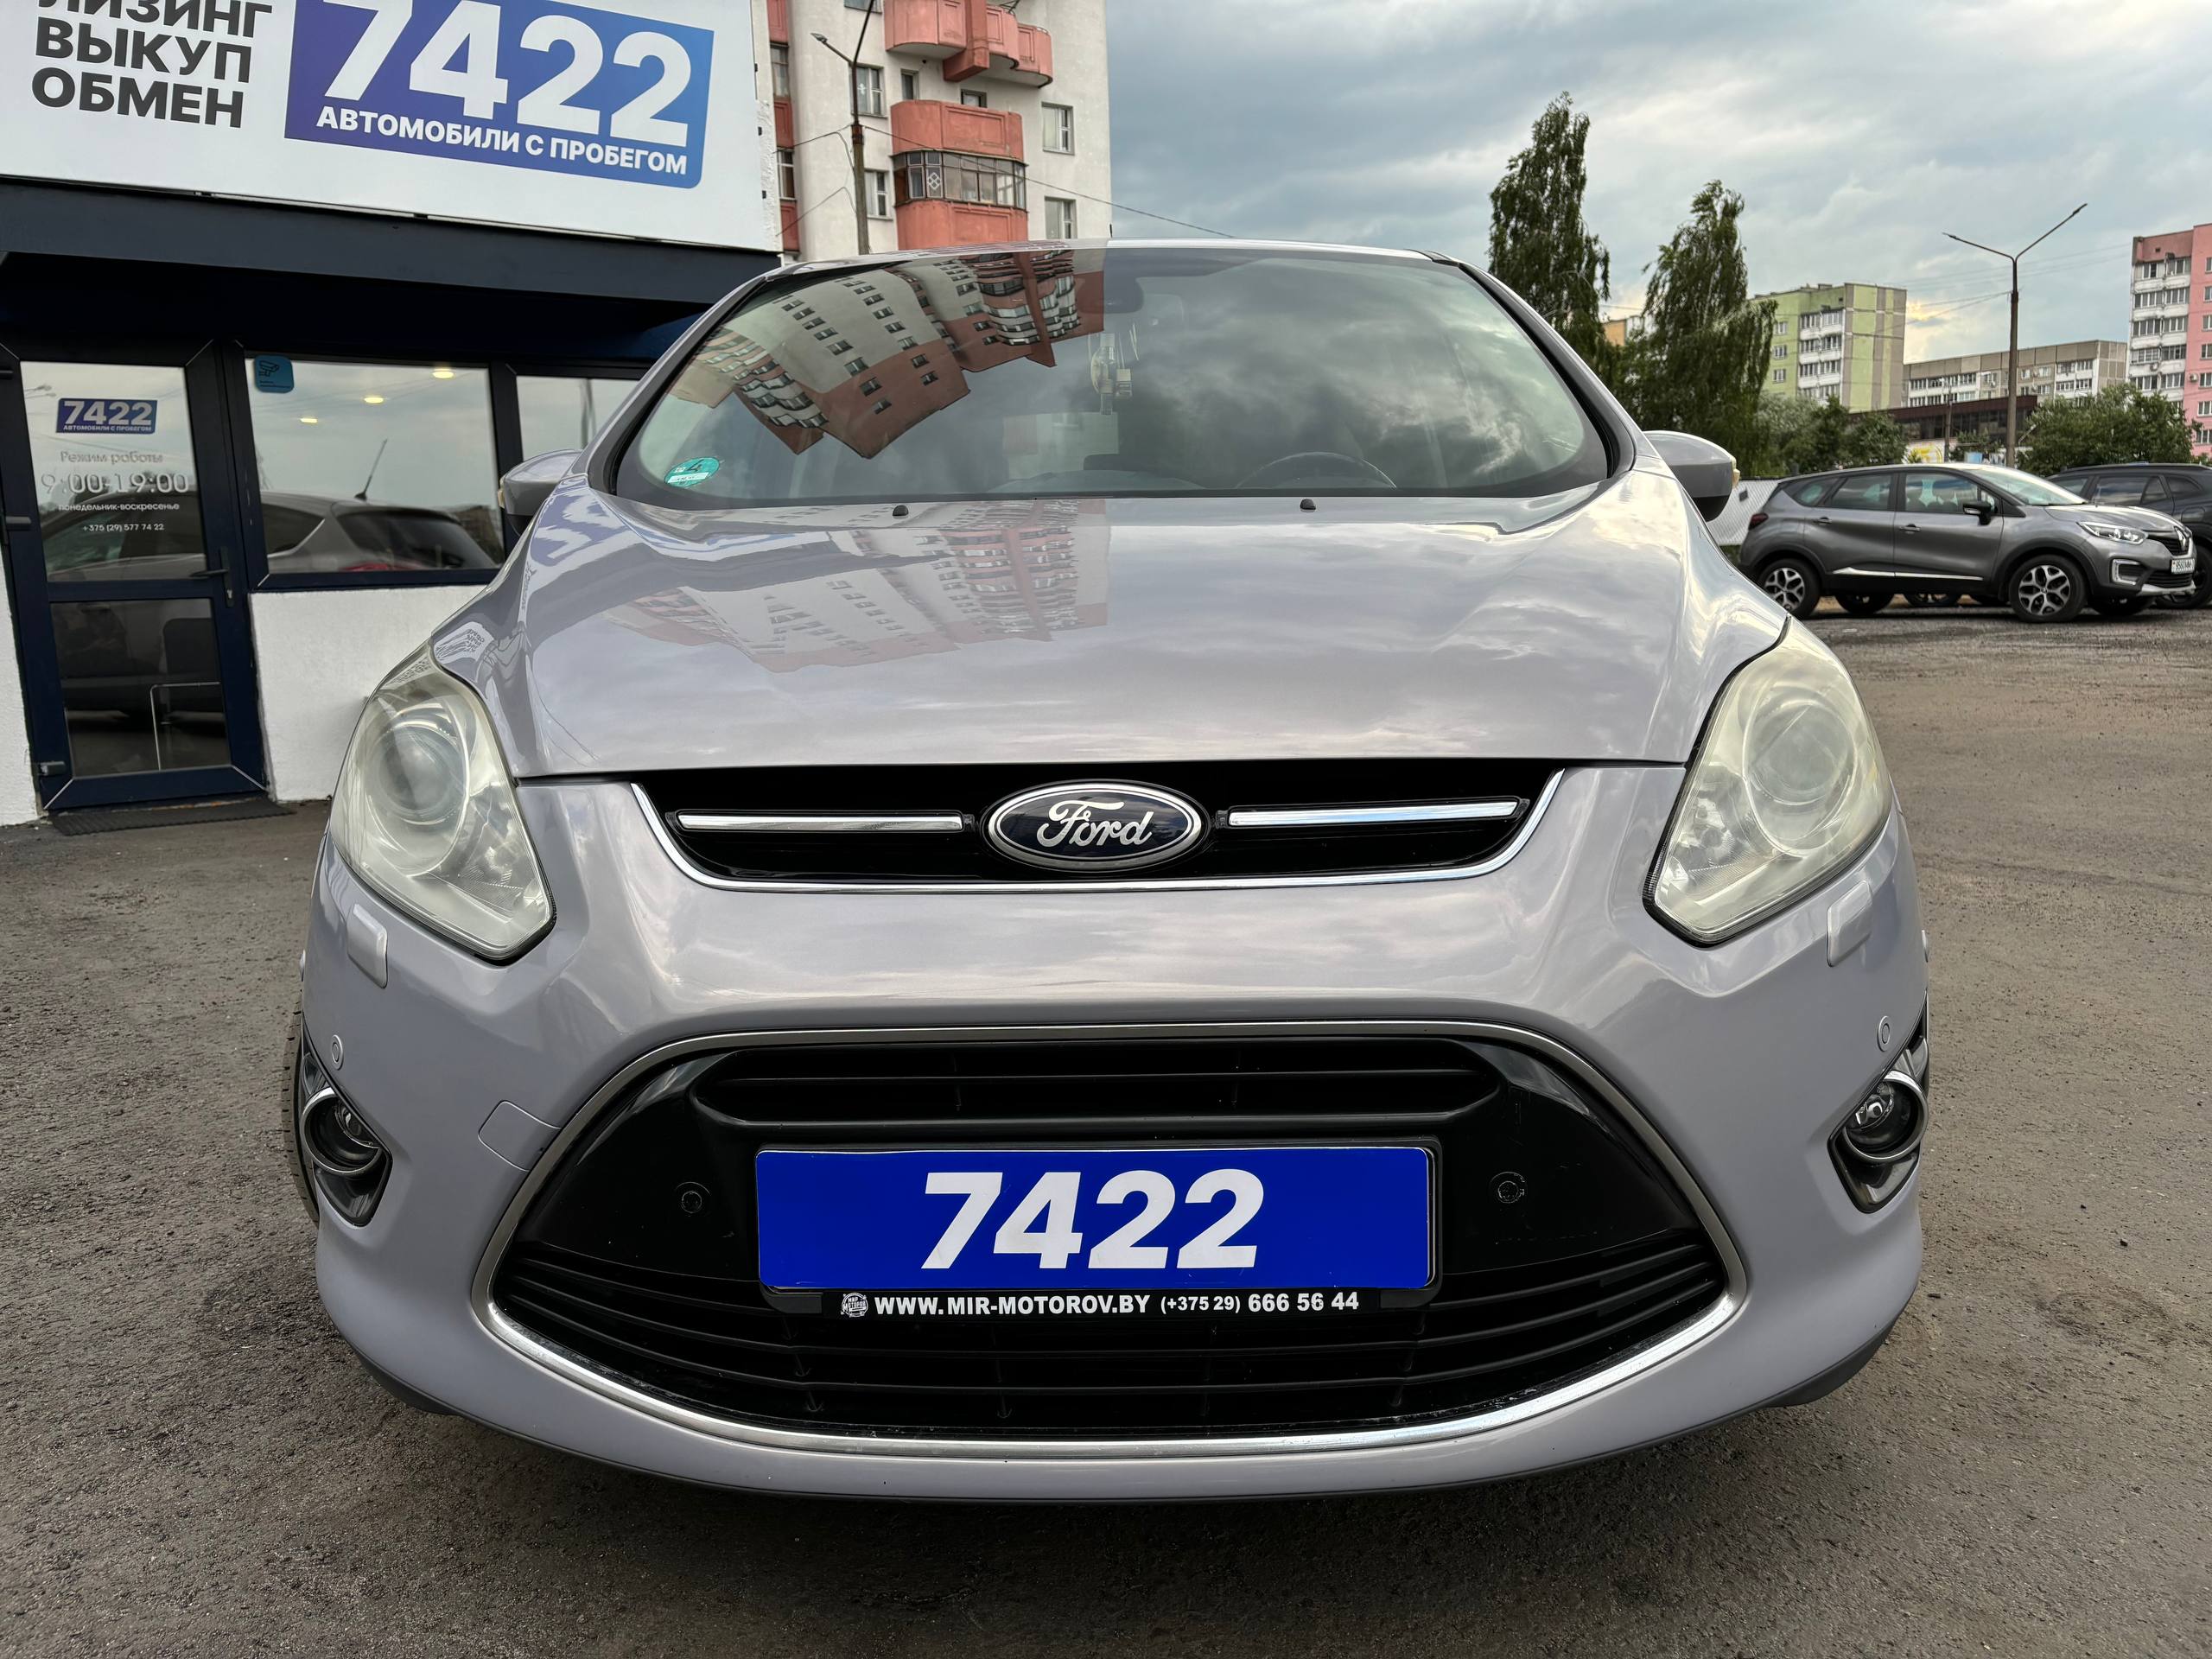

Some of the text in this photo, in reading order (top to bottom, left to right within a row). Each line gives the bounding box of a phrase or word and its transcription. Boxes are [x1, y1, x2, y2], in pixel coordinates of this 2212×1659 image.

[39, 0, 272, 38] ЗИНГ
[35, 16, 251, 83] ВЫКУП
[323, 0, 691, 147] 7422
[32, 67, 244, 128] ОБМЕН
[316, 106, 687, 175] АВТОМОБИЛИ С ПРОБЕГОМ
[64, 400, 152, 425] 7422
[60, 451, 163, 465] Режим работы
[41, 473, 189, 494] 9:00-19:00
[58, 504, 180, 512] понедельник-воскресенье
[106, 524, 123, 532] (29)
[124, 523, 139, 531] 577
[154, 523, 165, 531] 22
[1037, 800, 1154, 847] Ford
[921, 1168, 1265, 1268] 7422
[874, 1292, 1359, 1315] WWW.MIR-MOTOROV.BY (+375 29) 666 56 44
